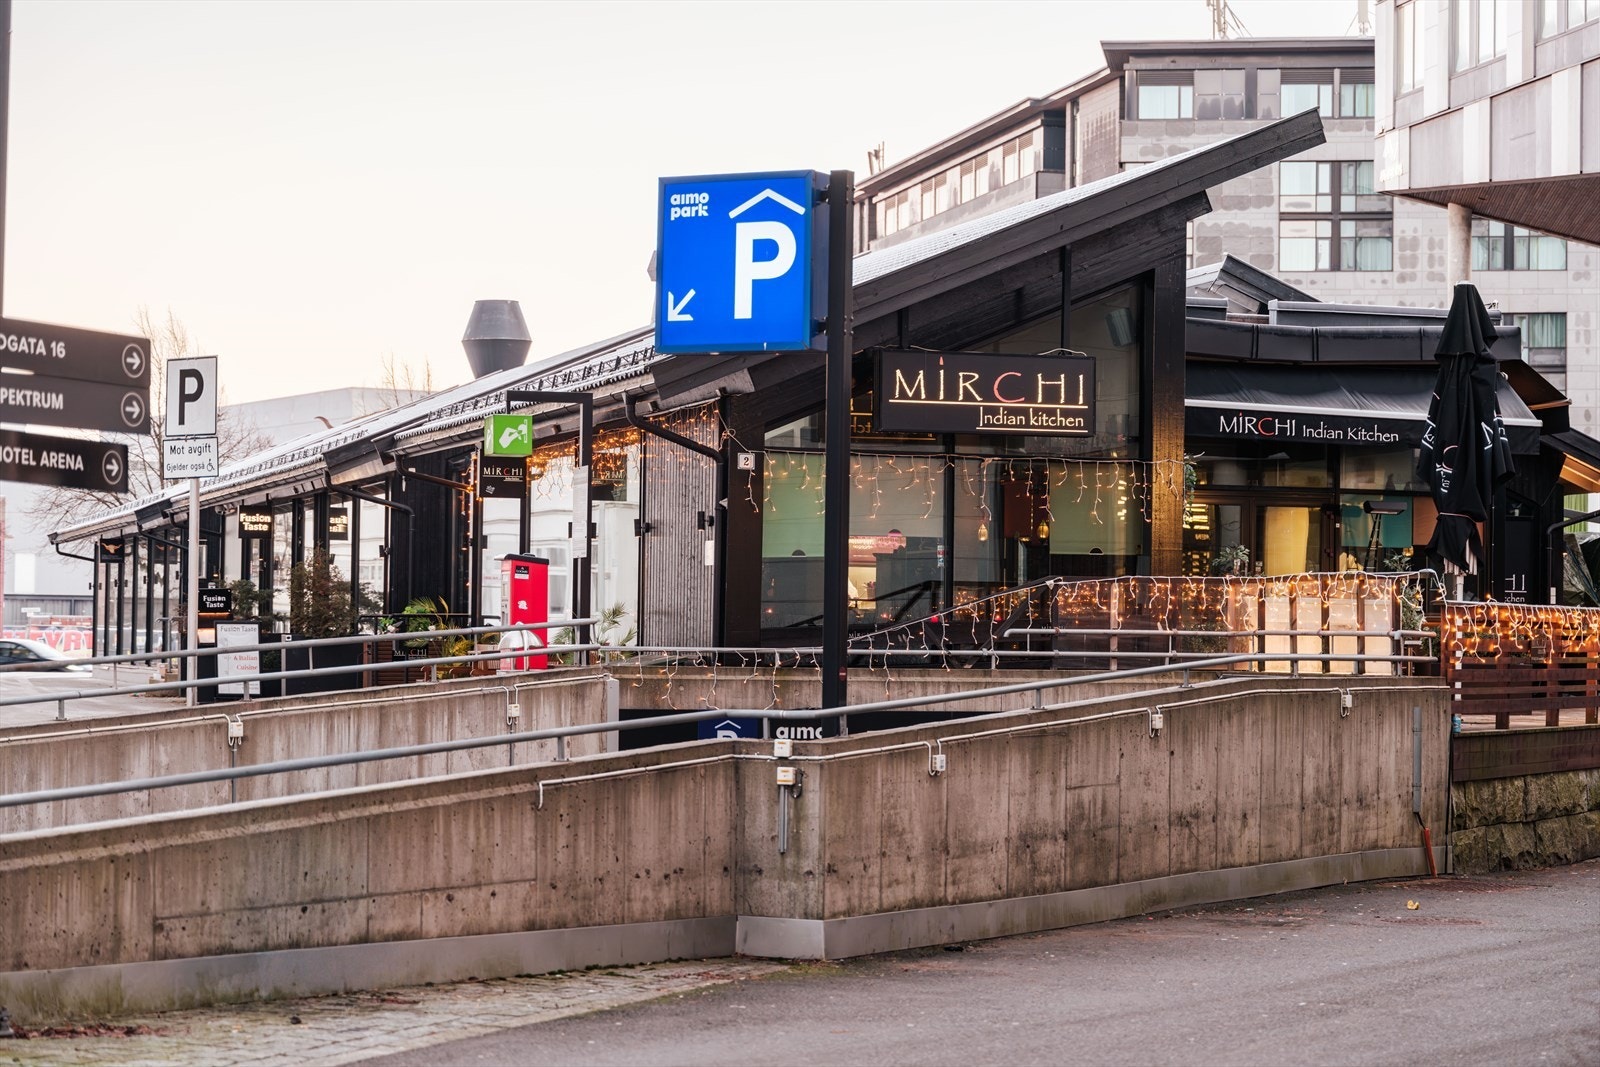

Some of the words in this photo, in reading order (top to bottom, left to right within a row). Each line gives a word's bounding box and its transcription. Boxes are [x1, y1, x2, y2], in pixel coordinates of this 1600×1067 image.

[670, 192, 709, 206] aimo
[670, 203, 709, 221] park
[734, 220, 797, 320] P
[50, 340, 66, 359] 16
[178, 368, 204, 426] P
[979, 406, 1026, 427] Indian
[1029, 407, 1084, 428] kitchen
[1302, 421, 1344, 440] Indian
[1347, 424, 1399, 443] Kitchen
[169, 445, 185, 455] Mot
[188, 443, 211, 456] avgift
[0, 445, 37, 467] OTEL
[40, 450, 84, 472] ARENA
[743, 456, 750, 466] 2
[166, 463, 189, 473] Gjelder
[239, 513, 272, 523] Fusion
[242, 522, 269, 532] Taste
[202, 594, 227, 602] Fusion
